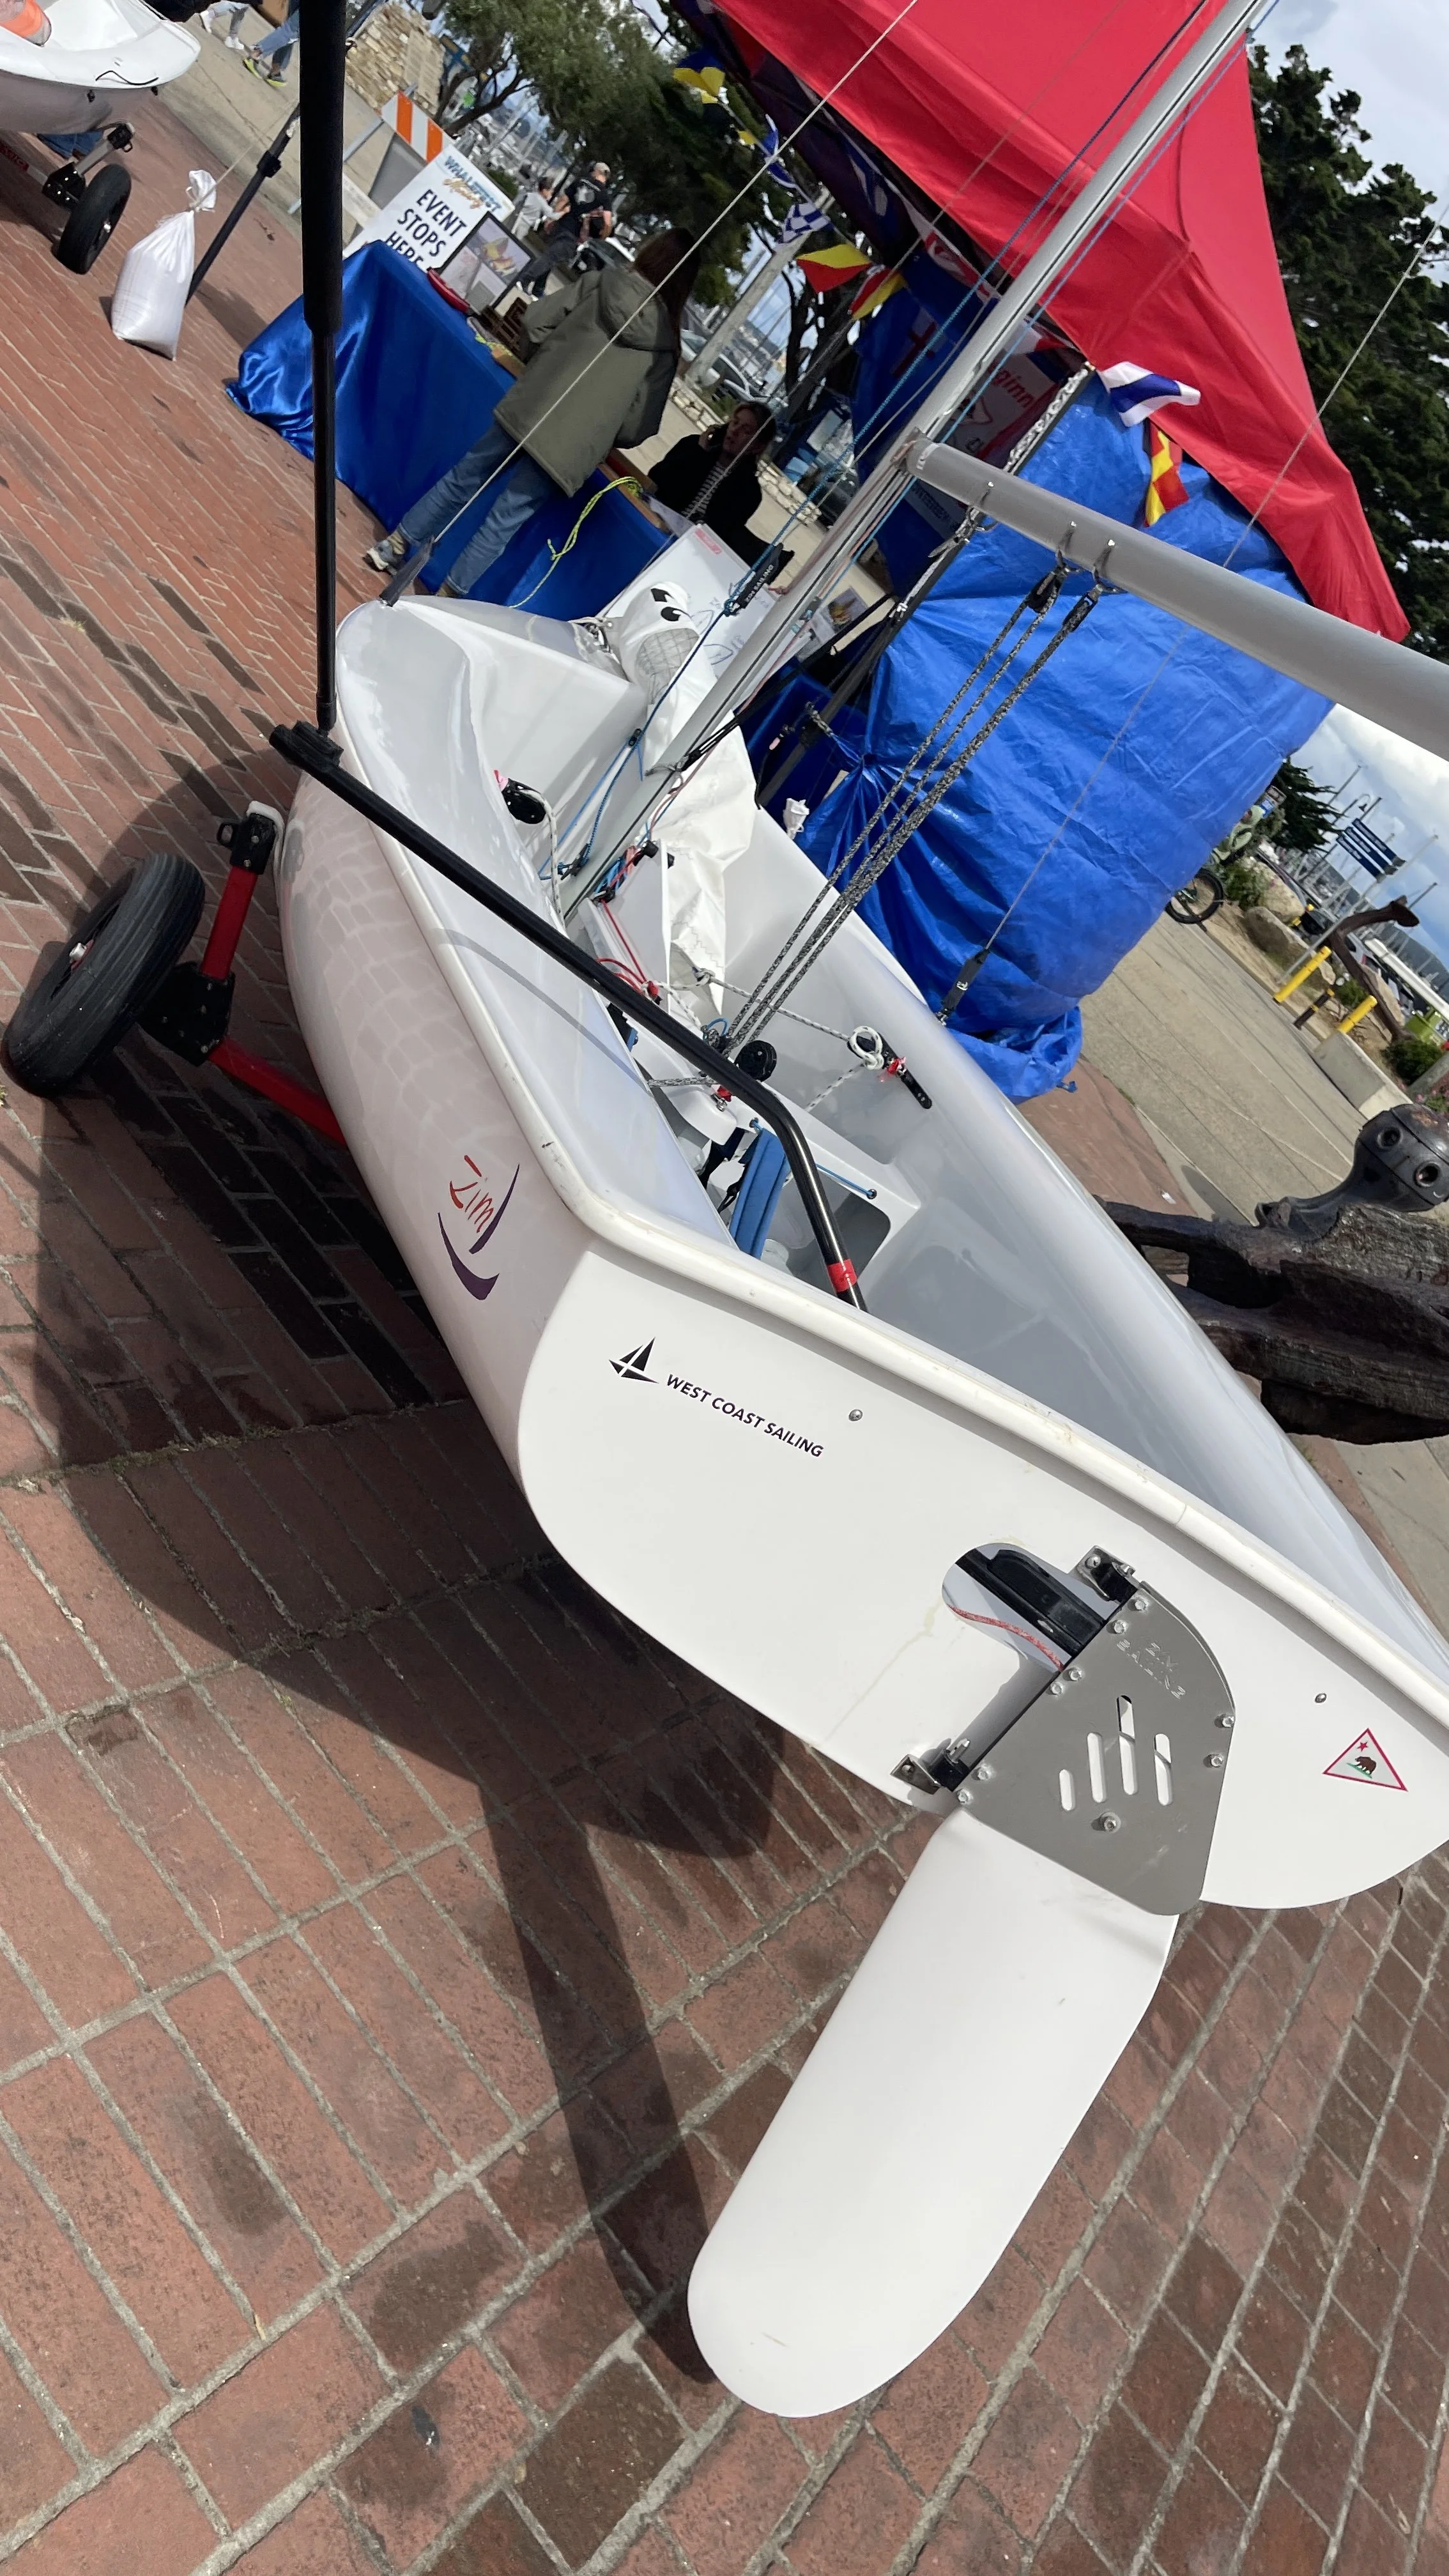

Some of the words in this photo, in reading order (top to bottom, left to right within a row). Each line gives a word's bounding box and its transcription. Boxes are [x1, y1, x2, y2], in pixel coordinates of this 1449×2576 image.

[397, 209, 446, 257] STOPS
[416, 189, 468, 236] EVENT
[666, 1374, 712, 1402] WEST
[712, 1397, 765, 1429] COAST
[764, 1422, 824, 1457] SAILING
